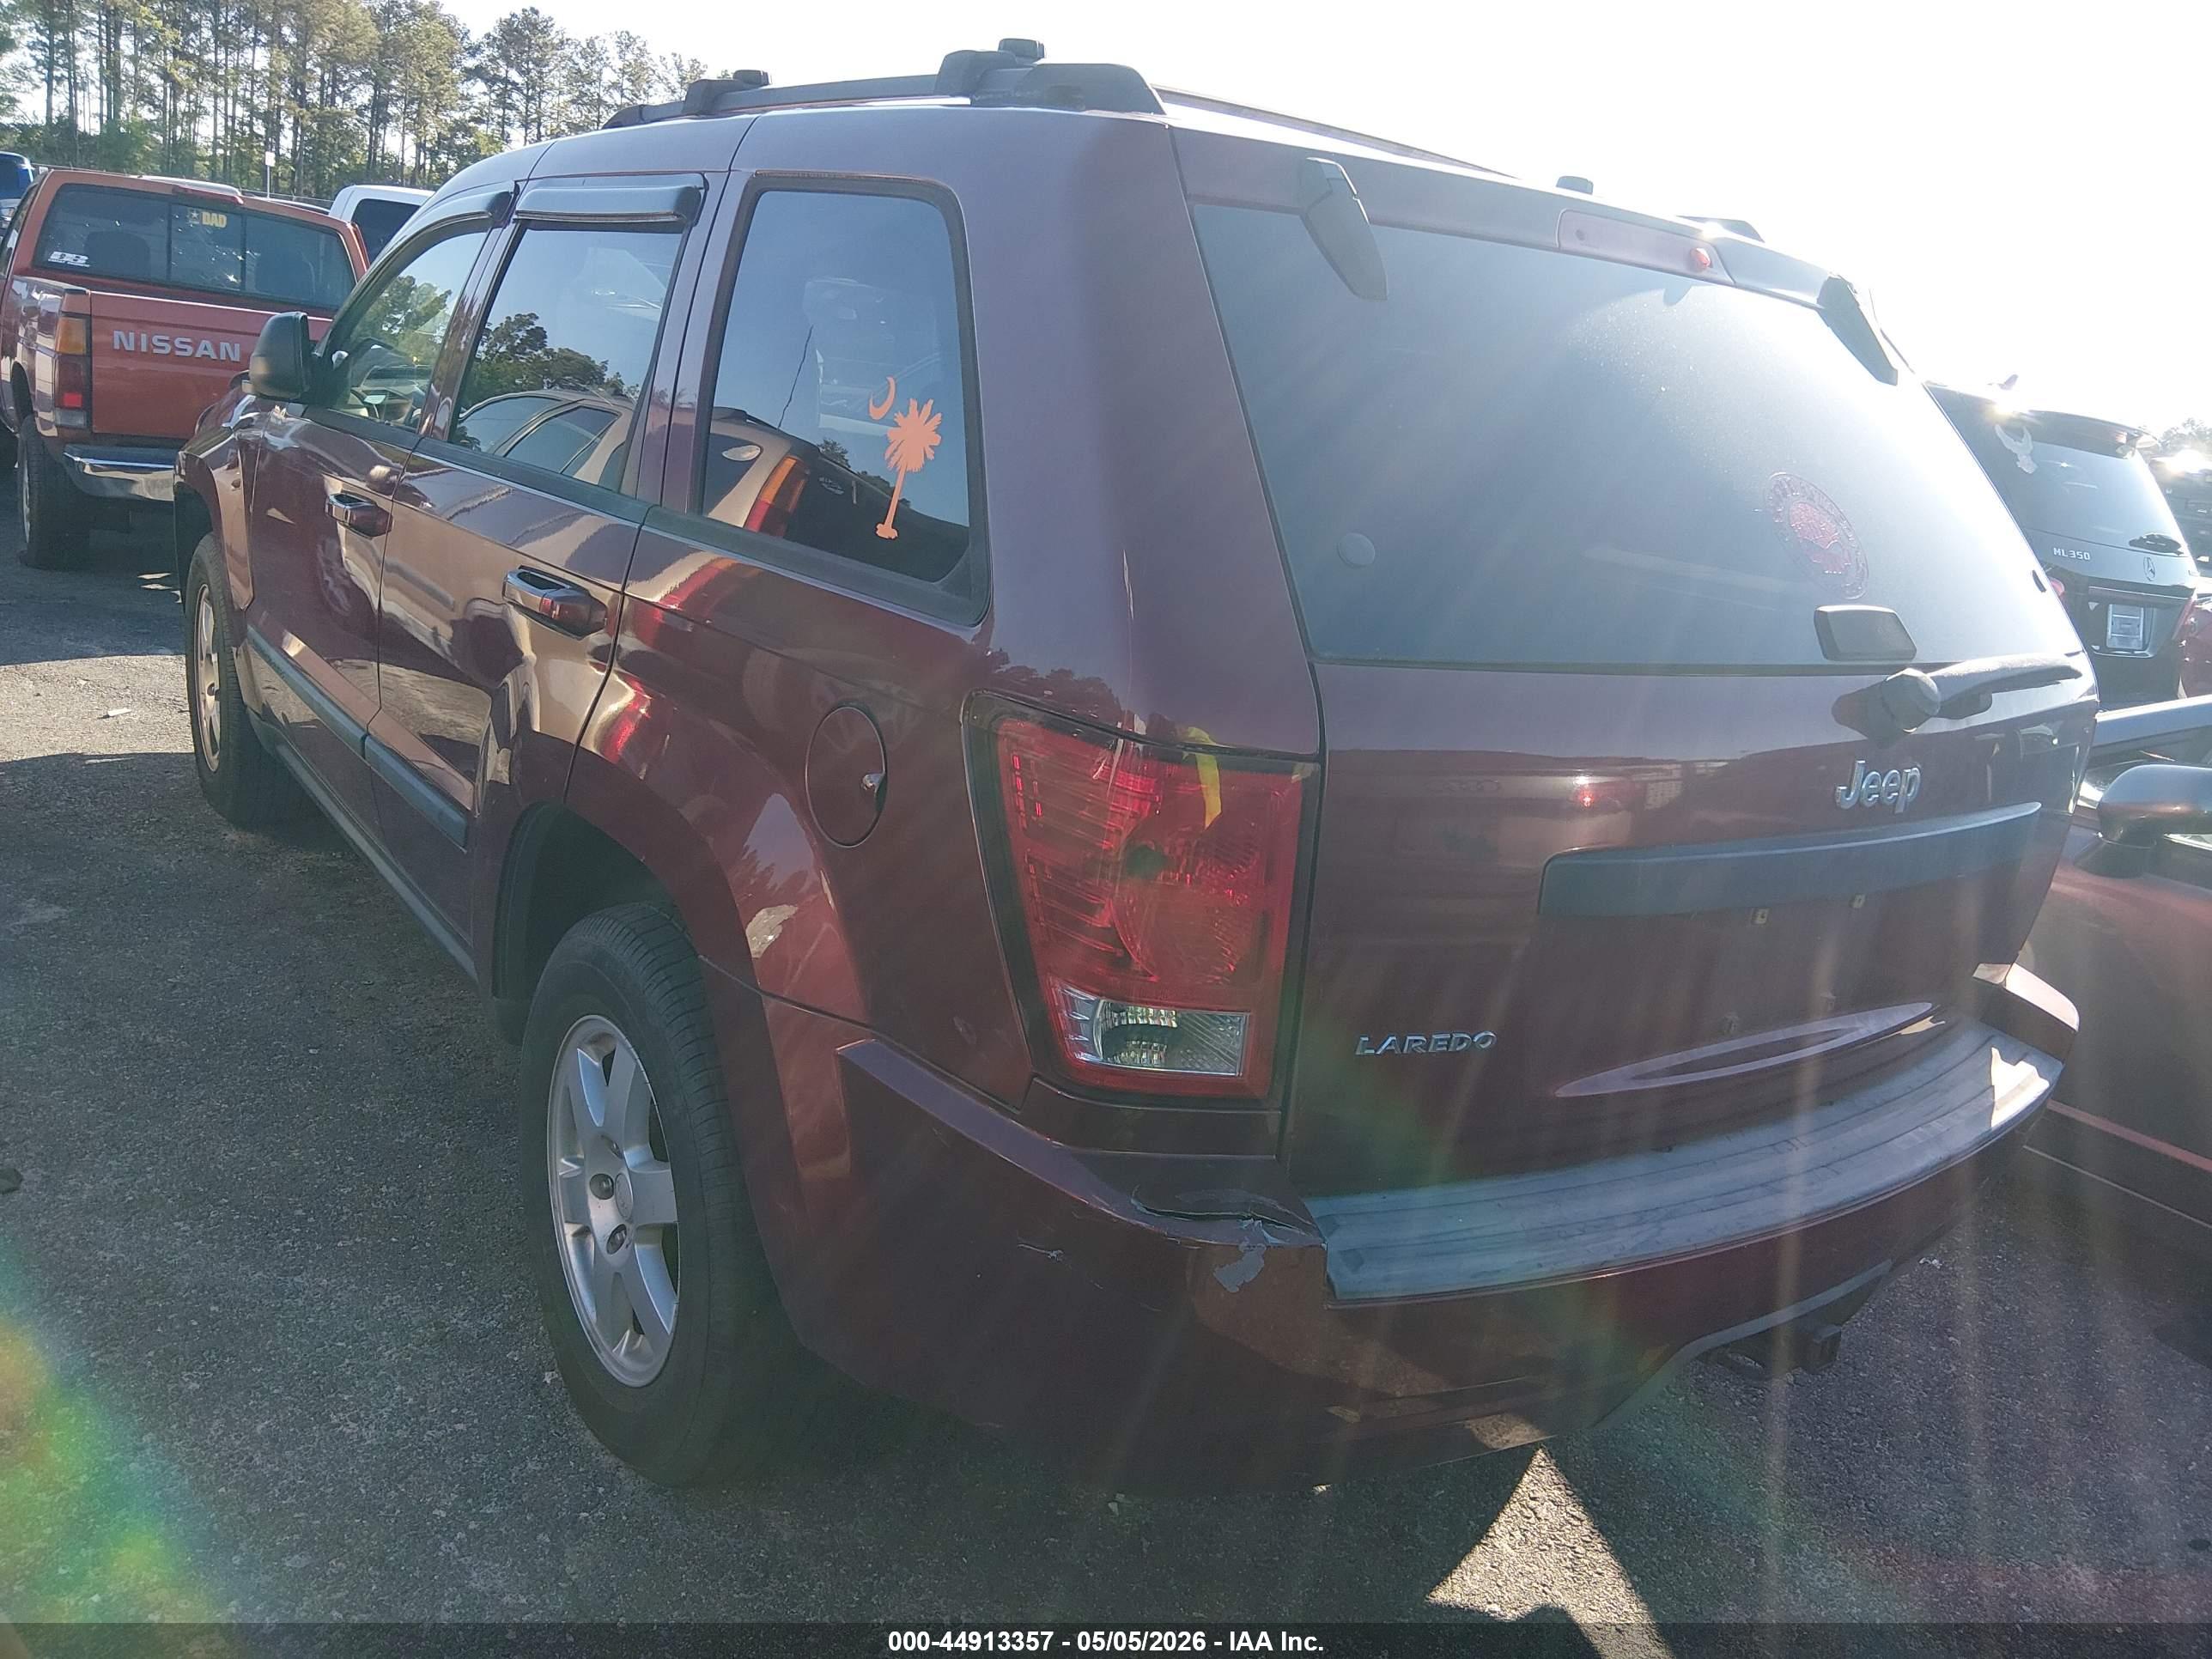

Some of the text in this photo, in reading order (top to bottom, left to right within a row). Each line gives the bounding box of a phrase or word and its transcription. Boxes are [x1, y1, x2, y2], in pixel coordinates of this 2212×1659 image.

[202, 211, 228, 228] DAD
[112, 330, 241, 362] NISSAN
[1834, 759, 1922, 815] Jeep
[1354, 1030, 1498, 1055] LAREDO
